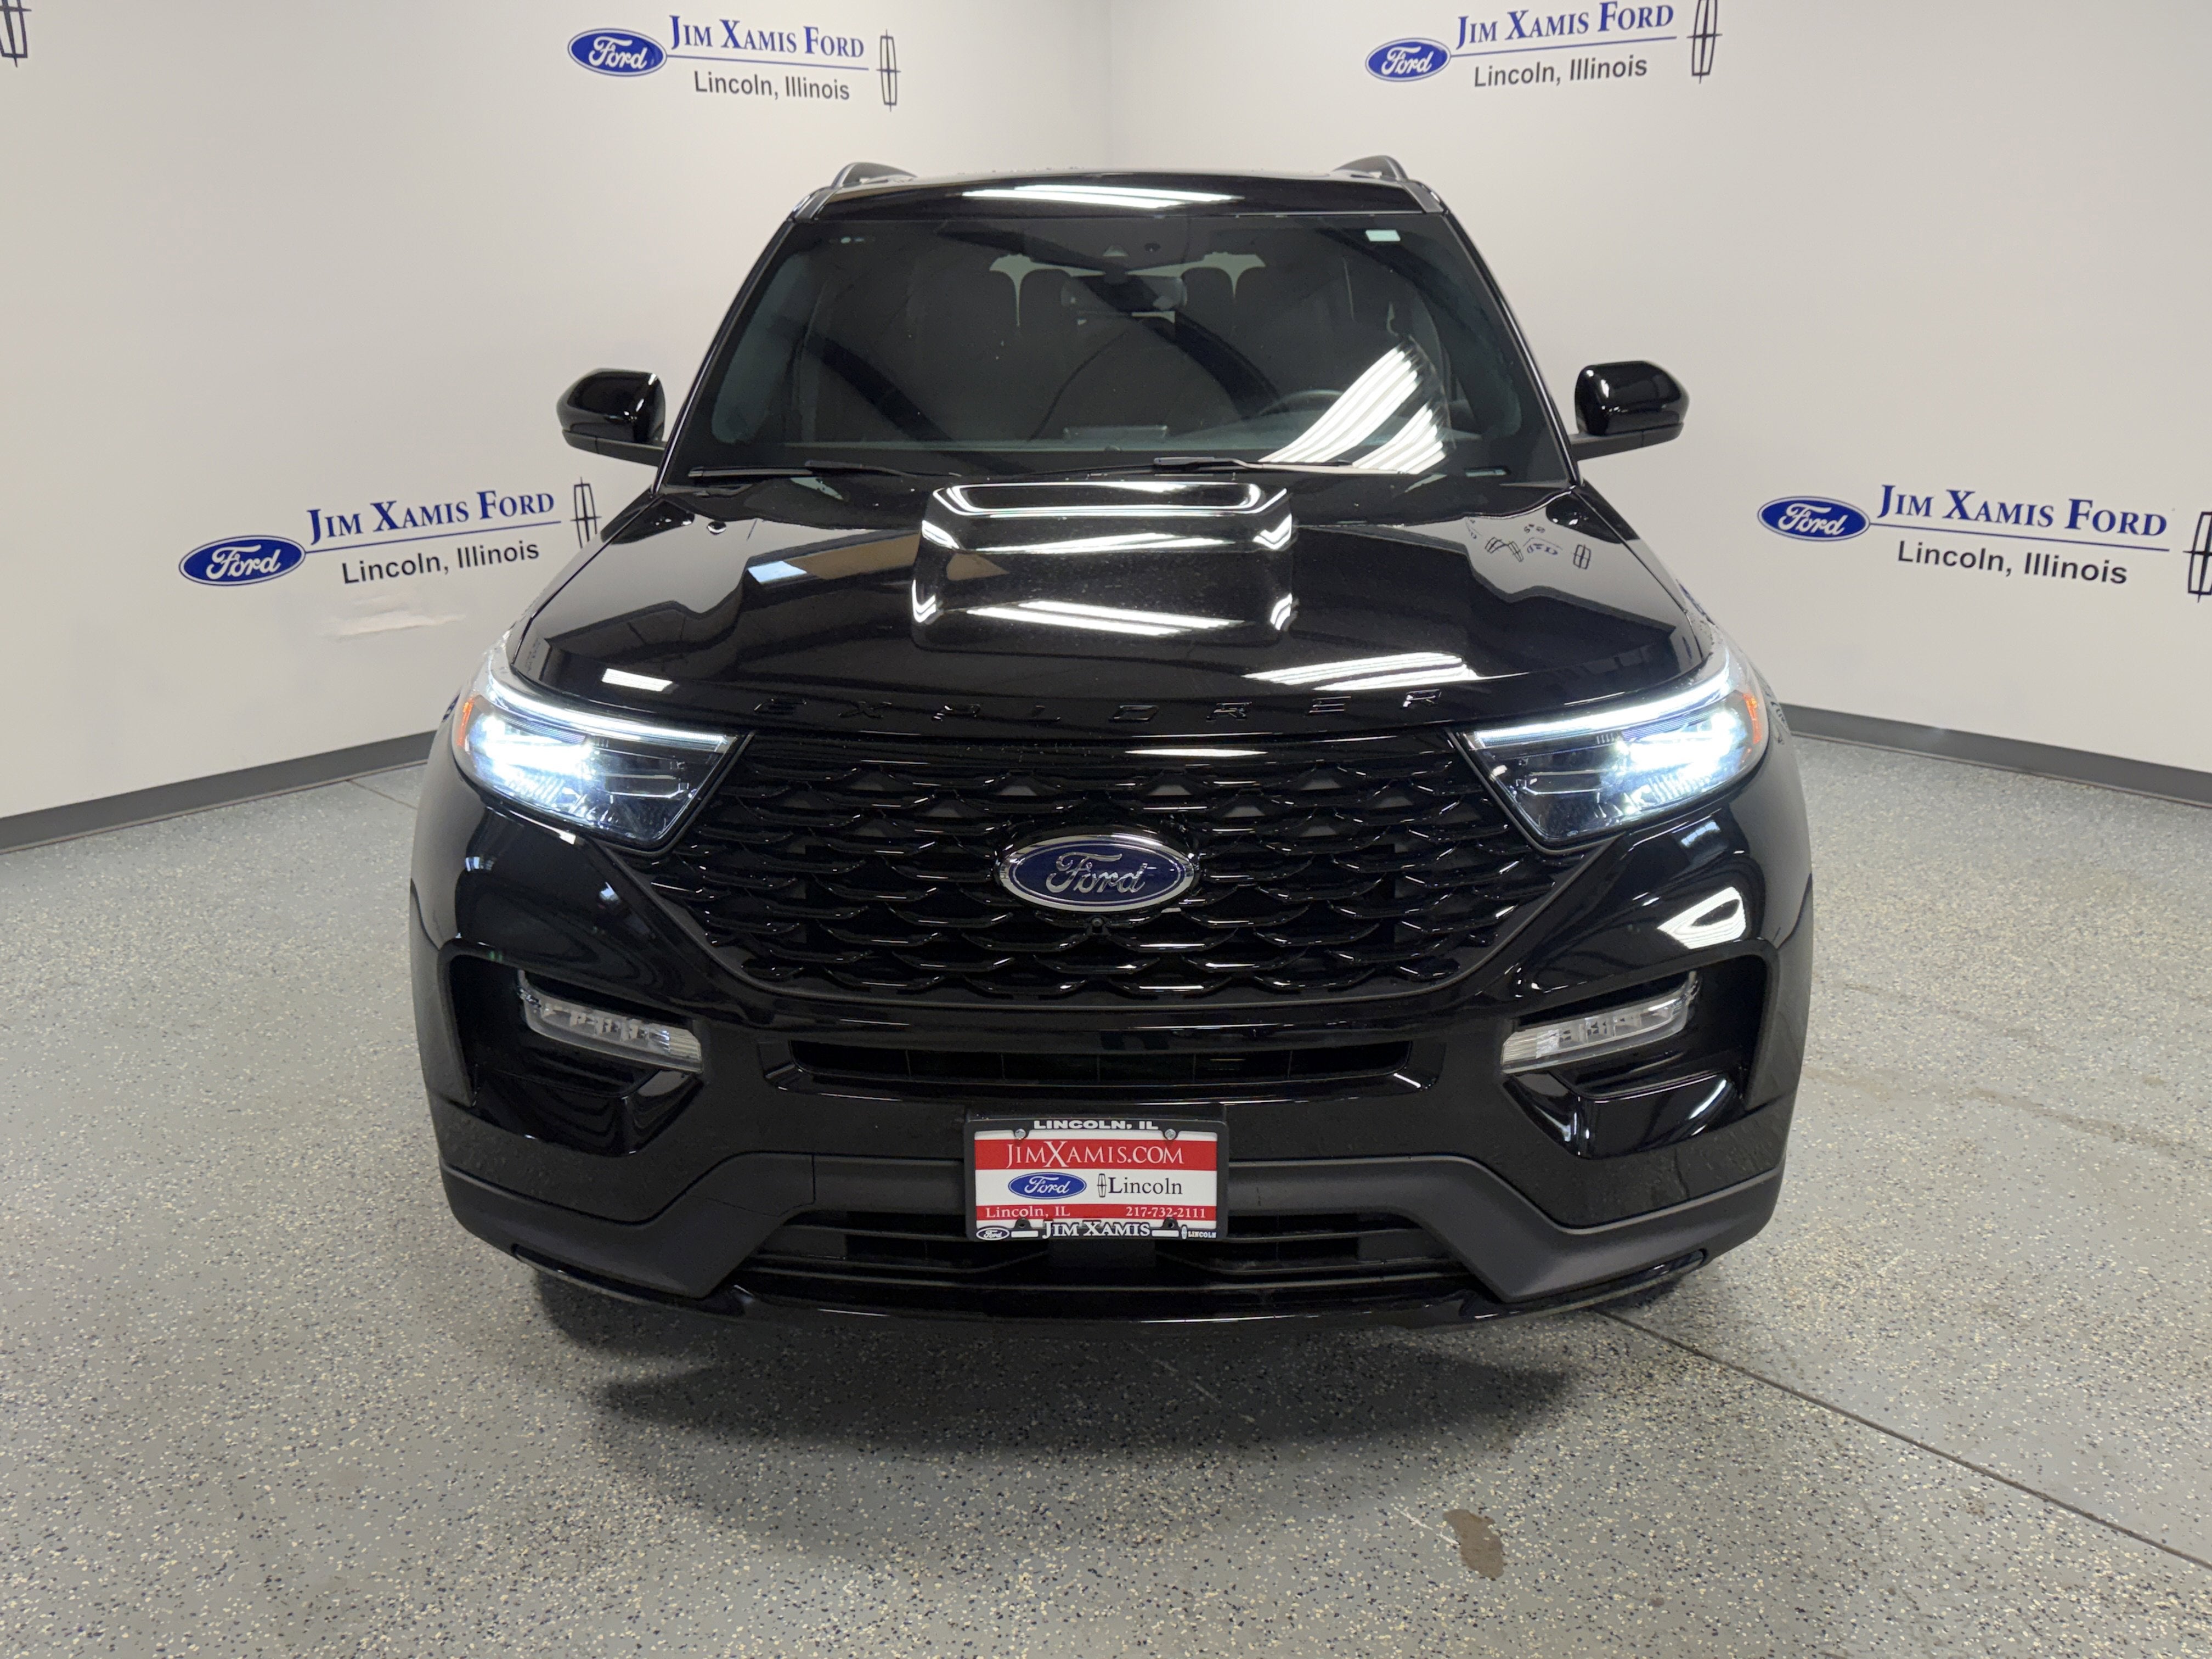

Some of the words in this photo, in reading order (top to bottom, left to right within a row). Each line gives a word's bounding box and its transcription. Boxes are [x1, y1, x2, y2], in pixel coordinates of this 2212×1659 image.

[589, 36, 647, 69] Ford
[1380, 46, 1434, 75] Ford
[694, 71, 778, 99] Lincoln,
[786, 76, 850, 100] Illinois
[1474, 60, 1562, 88] Lincoln,
[1570, 55, 1647, 81] Illinois
[1777, 503, 1846, 537] Ford
[205, 545, 282, 580] Ford
[342, 554, 449, 584] Lincoln,
[457, 540, 540, 569] Illinois
[1897, 541, 2012, 577] Lincoln,
[2024, 553, 2128, 584] Illinois
[1046, 852, 1148, 893] Ford
[1034, 1120, 1132, 1130] LINCOLN,
[1138, 1121, 1159, 1130] IL
[1024, 1176, 1070, 1194] Ford
[1108, 1177, 1183, 1194] Lincoln
[985, 1206, 1048, 1218] Lincoln,
[1056, 1206, 1070, 1216] IL
[1126, 1206, 1206, 1218] 217-732-2111
[1042, 1221, 1080, 1239] JIM
[1083, 1221, 1150, 1237] XAMIS
